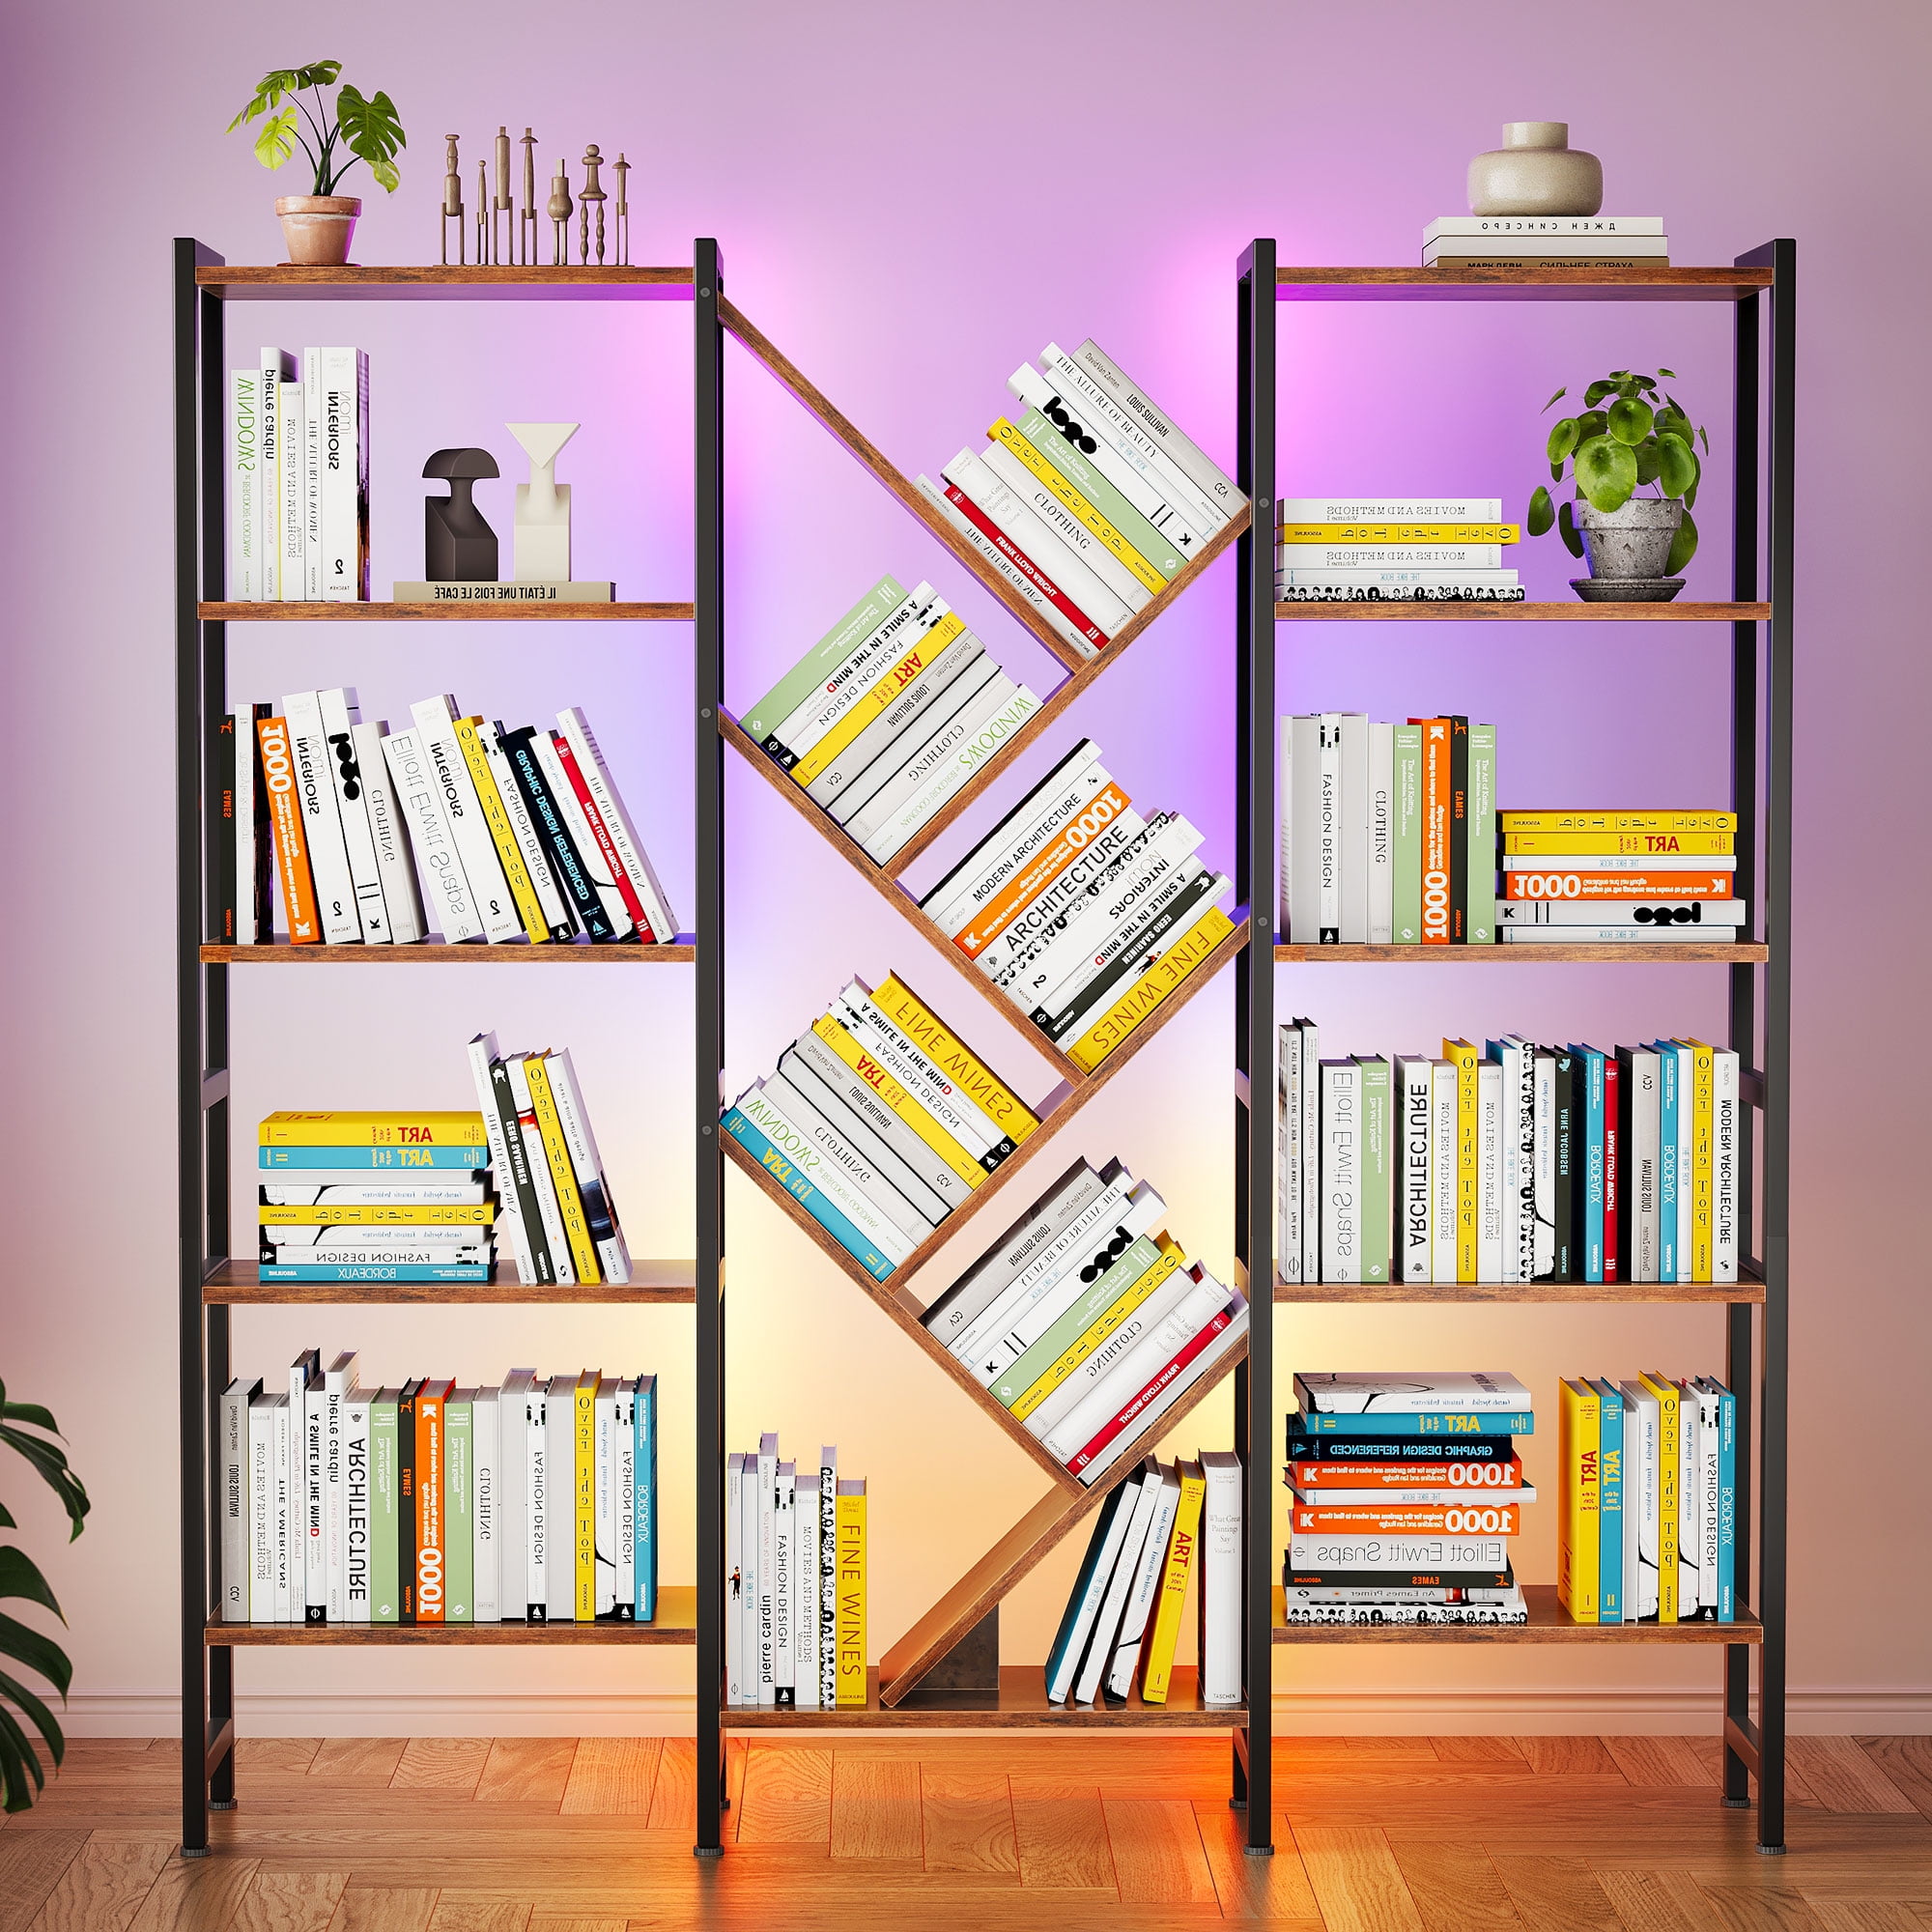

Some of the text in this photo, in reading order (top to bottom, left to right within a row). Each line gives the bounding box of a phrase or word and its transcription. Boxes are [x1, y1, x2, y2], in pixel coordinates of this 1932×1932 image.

[1126, 393, 1170, 438] LOUIS SULLIVAN
[1000, 426, 1040, 468] Over
[1052, 478, 1081, 507] the
[1087, 514, 1122, 551] Top
[1034, 493, 1091, 550] CLOTHING
[995, 535, 1058, 597] FRANK LLOYD WRIGHT
[818, 639, 904, 726] FASHION DESIGN
[826, 600, 918, 694] A SMILE IN THE MIND
[893, 652, 923, 688] ART
[887, 683, 930, 727] LOUIS SULLIVAN
[958, 696, 1035, 770] WINDOWS
[908, 724, 965, 781] CLOTHING
[1065, 789, 1122, 848] 1000
[1321, 774, 1332, 888] FASHION DESIGN
[1375, 790, 1386, 864] CLOTHING
[1455, 790, 1463, 819] EAMES
[972, 793, 1082, 902] MODERN ARCHITECTURE
[1006, 825, 1129, 952] ARCHITECTURE
[1094, 872, 1186, 966] A SMILE IN THE MIND
[1109, 858, 1170, 920] INTERIORS
[1424, 870, 1448, 939] 1000
[1121, 913, 1173, 965] EERO SAARINEN
[1032, 974, 1047, 989] 2
[1093, 930, 1210, 1050] FINE WINES
[1172, 1530, 1193, 1568] ART
[777, 1535, 788, 1648] FASHION DESIGN
[803, 1526, 812, 1663] MOVIES AND METHODS
[841, 1525, 862, 1675] FINE WINES
[759, 1595, 774, 1684] pierre cardin
